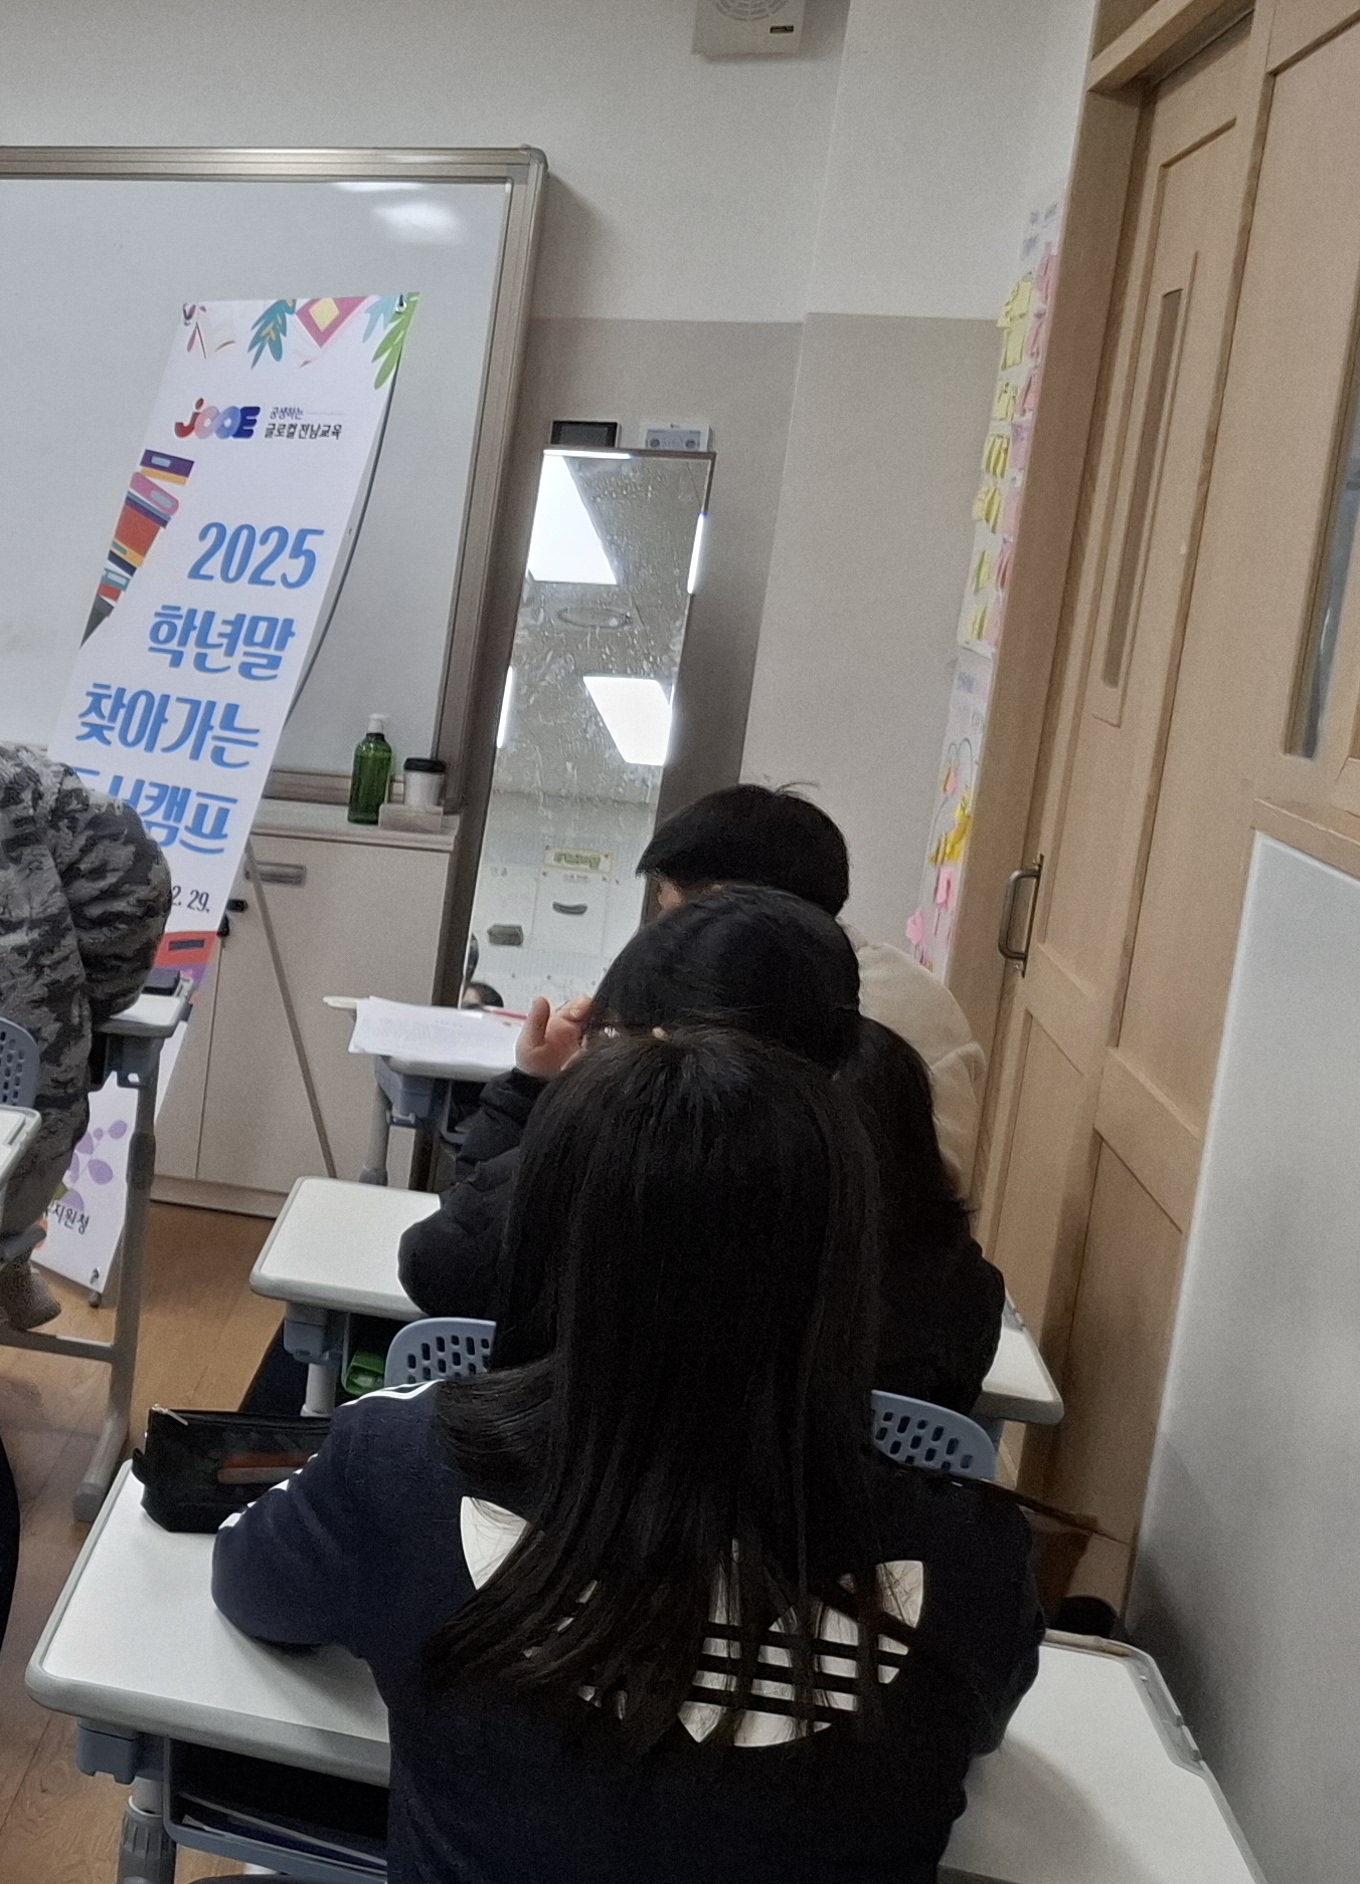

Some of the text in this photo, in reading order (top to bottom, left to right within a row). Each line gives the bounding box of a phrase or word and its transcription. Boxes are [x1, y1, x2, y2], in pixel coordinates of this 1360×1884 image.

[264, 423, 342, 440] 글로컬 전남교육
[188, 522, 325, 589] 2025
[148, 604, 296, 681] 학년말
[75, 683, 260, 769] 찾아가는
[186, 889, 209, 912] 29.
[46, 1204, 90, 1235] 지원청
